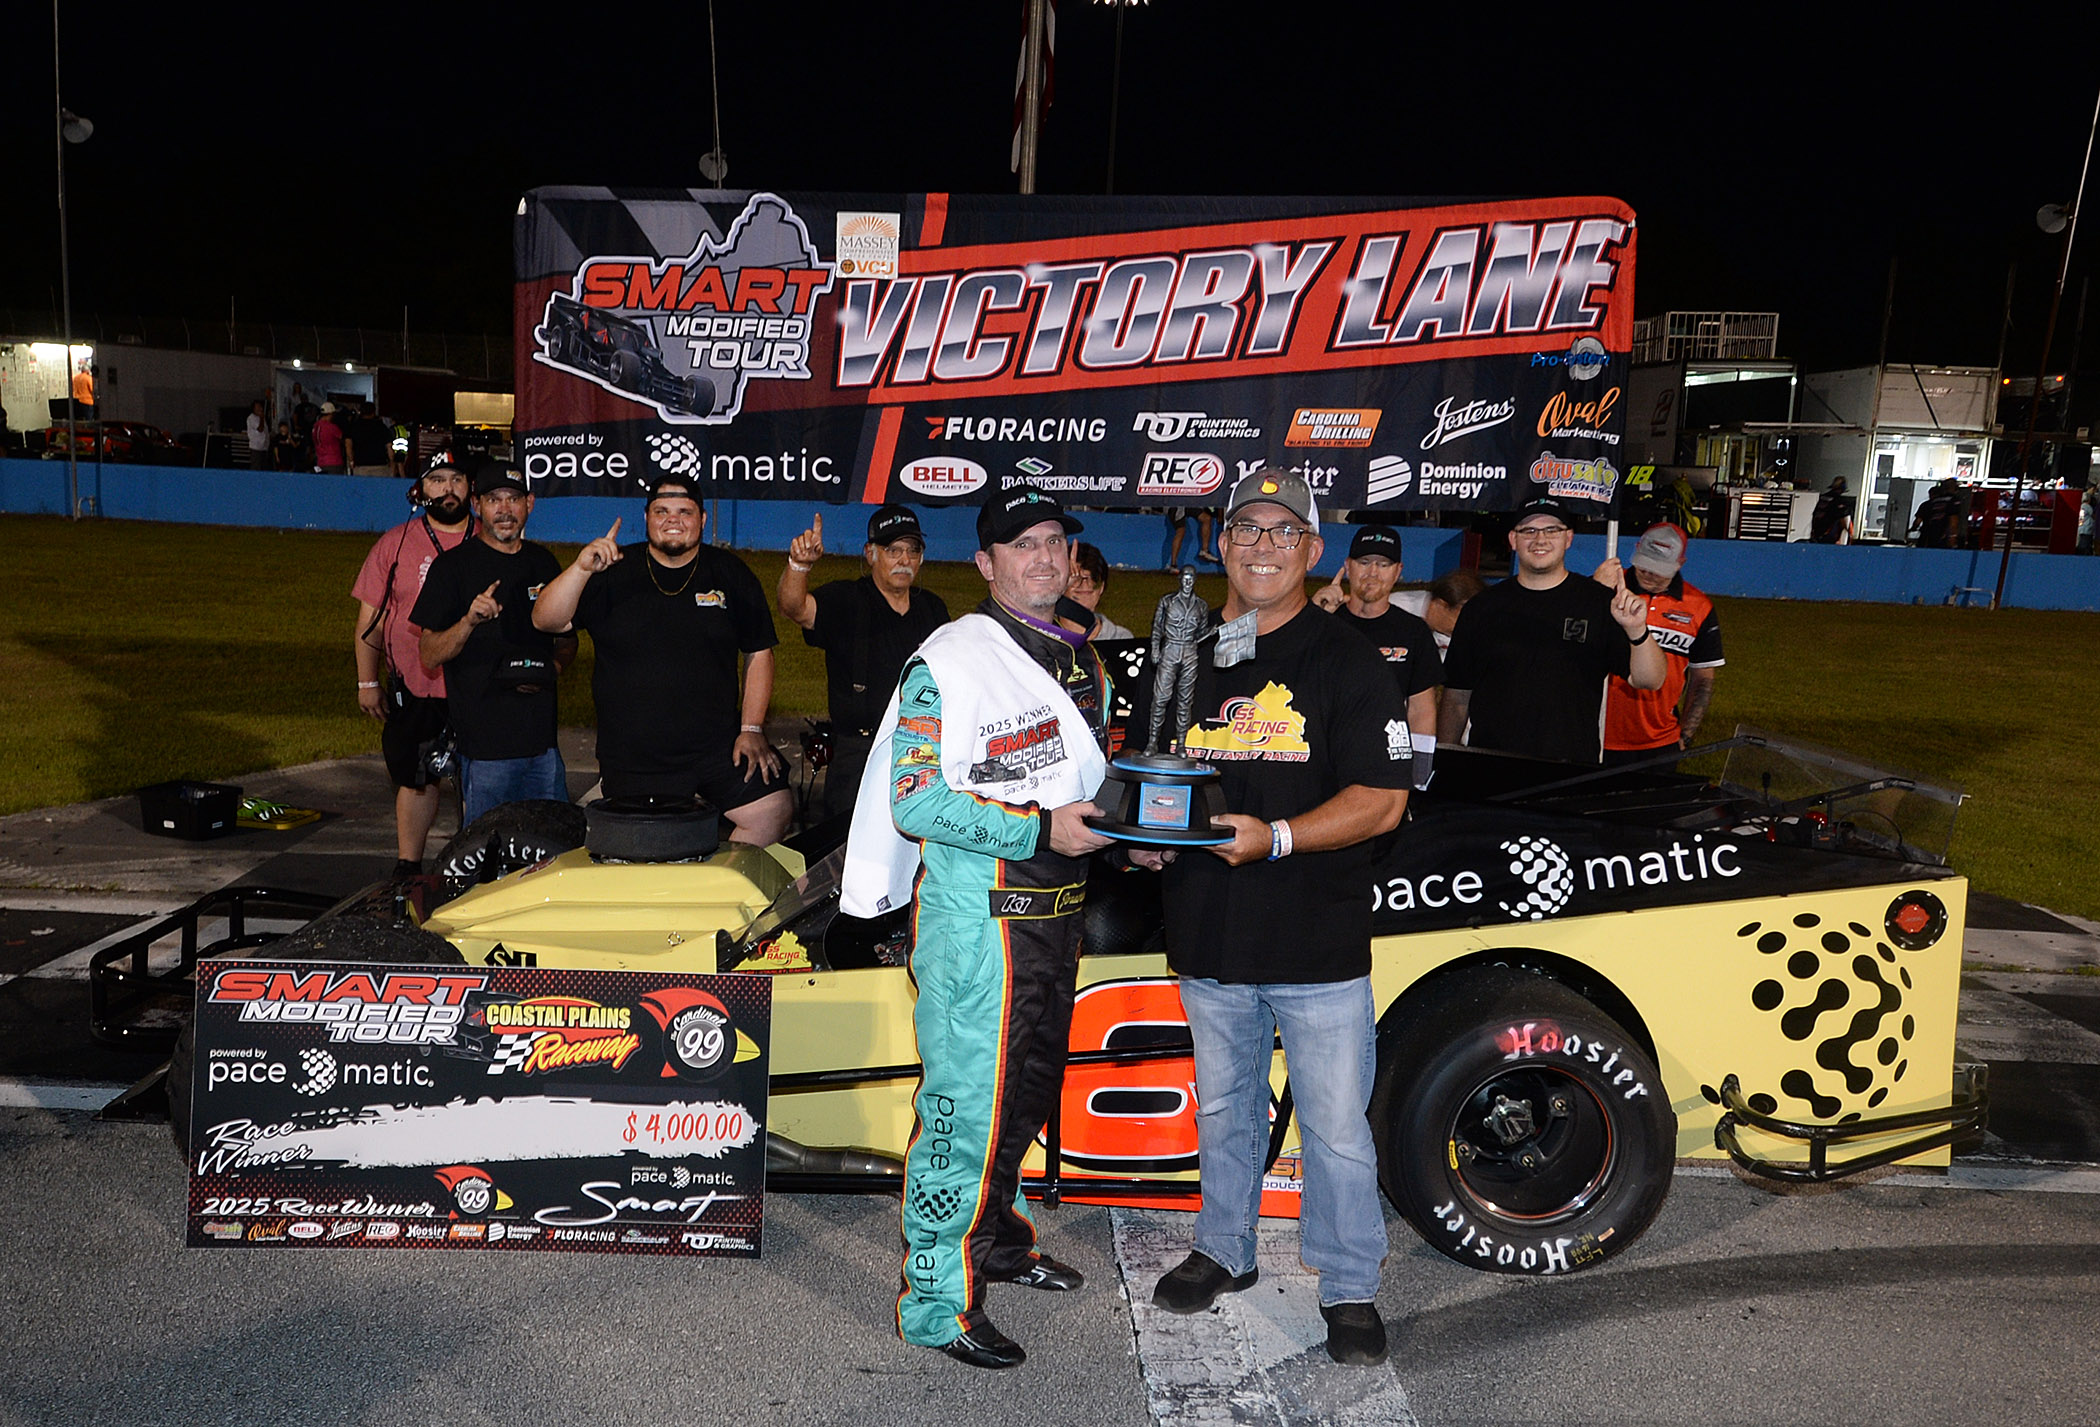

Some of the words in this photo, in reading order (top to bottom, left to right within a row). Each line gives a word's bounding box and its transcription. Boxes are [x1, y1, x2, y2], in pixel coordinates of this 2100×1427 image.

[857, 260, 894, 275] VCU
[583, 264, 830, 313] SMART
[838, 242, 1334, 386] VICTORY
[1334, 219, 1625, 348] LANE
[666, 317, 804, 339] MODIFIED
[687, 341, 802, 370] TOUR
[1190, 418, 1248, 428] PRINTING
[1297, 410, 1360, 425] CAROLINA
[1420, 396, 1515, 450] Jostens
[1537, 387, 1621, 437] Oval
[525, 435, 584, 448] powered
[588, 433, 604, 448] by
[945, 416, 1107, 442] FLORACING
[1186, 429, 1196, 438] &
[1199, 428, 1260, 438] GRAPHICS
[1310, 425, 1372, 439] DRILLING
[1552, 428, 1620, 445] Marketing
[525, 452, 629, 491] pace
[913, 467, 977, 482] BELL
[1420, 462, 1506, 479] Dominion
[1625, 466, 1655, 485] 18
[1419, 480, 1484, 499] Energy
[1550, 481, 1611, 497] CLEANERS
[979, 719, 1012, 737] 2025
[1015, 705, 1053, 725] WINNER
[988, 718, 1060, 758] SMART
[1000, 736, 1063, 766] MODIFIED
[1028, 748, 1064, 772] TOUR
[1262, 752, 1310, 762] RACING
[932, 815, 967, 835] pace
[989, 836, 1026, 848] matic
[1372, 870, 1483, 912] ace
[1585, 834, 1742, 890] matic
[767, 952, 800, 960] RACING
[215, 972, 483, 1004] SMART
[244, 1002, 461, 1023] MODIFIED
[486, 1004, 565, 1026] COASTAL
[568, 1006, 631, 1029] PLAINS
[673, 1005, 728, 1031] Cardinal
[329, 1022, 455, 1043] TOUR
[680, 1028, 722, 1059] 99
[209, 1049, 252, 1059] powered
[254, 1048, 267, 1060] by
[524, 1033, 639, 1072] Raceway
[1504, 1023, 1648, 1099] Hoosier
[208, 1062, 287, 1091] pace
[206, 1119, 296, 1147] Race
[622, 1111, 637, 1143] $
[645, 1112, 742, 1144] 4,000.00
[927, 1092, 955, 1171] pace
[197, 1143, 312, 1176] Winner
[631, 1171, 667, 1186] pace
[201, 1197, 271, 1216] 2025
[274, 1198, 342, 1216] Race
[342, 1194, 435, 1217] Winner
[462, 1189, 488, 1209] 99
[534, 1181, 745, 1226] Smart
[248, 1219, 286, 1241] Oval
[405, 1225, 447, 1237] Hoosier
[507, 1226, 540, 1234] Dominion
[507, 1233, 533, 1241] Energy
[553, 1229, 616, 1242] FLORACING
[1434, 1201, 1573, 1274] Hoosier
